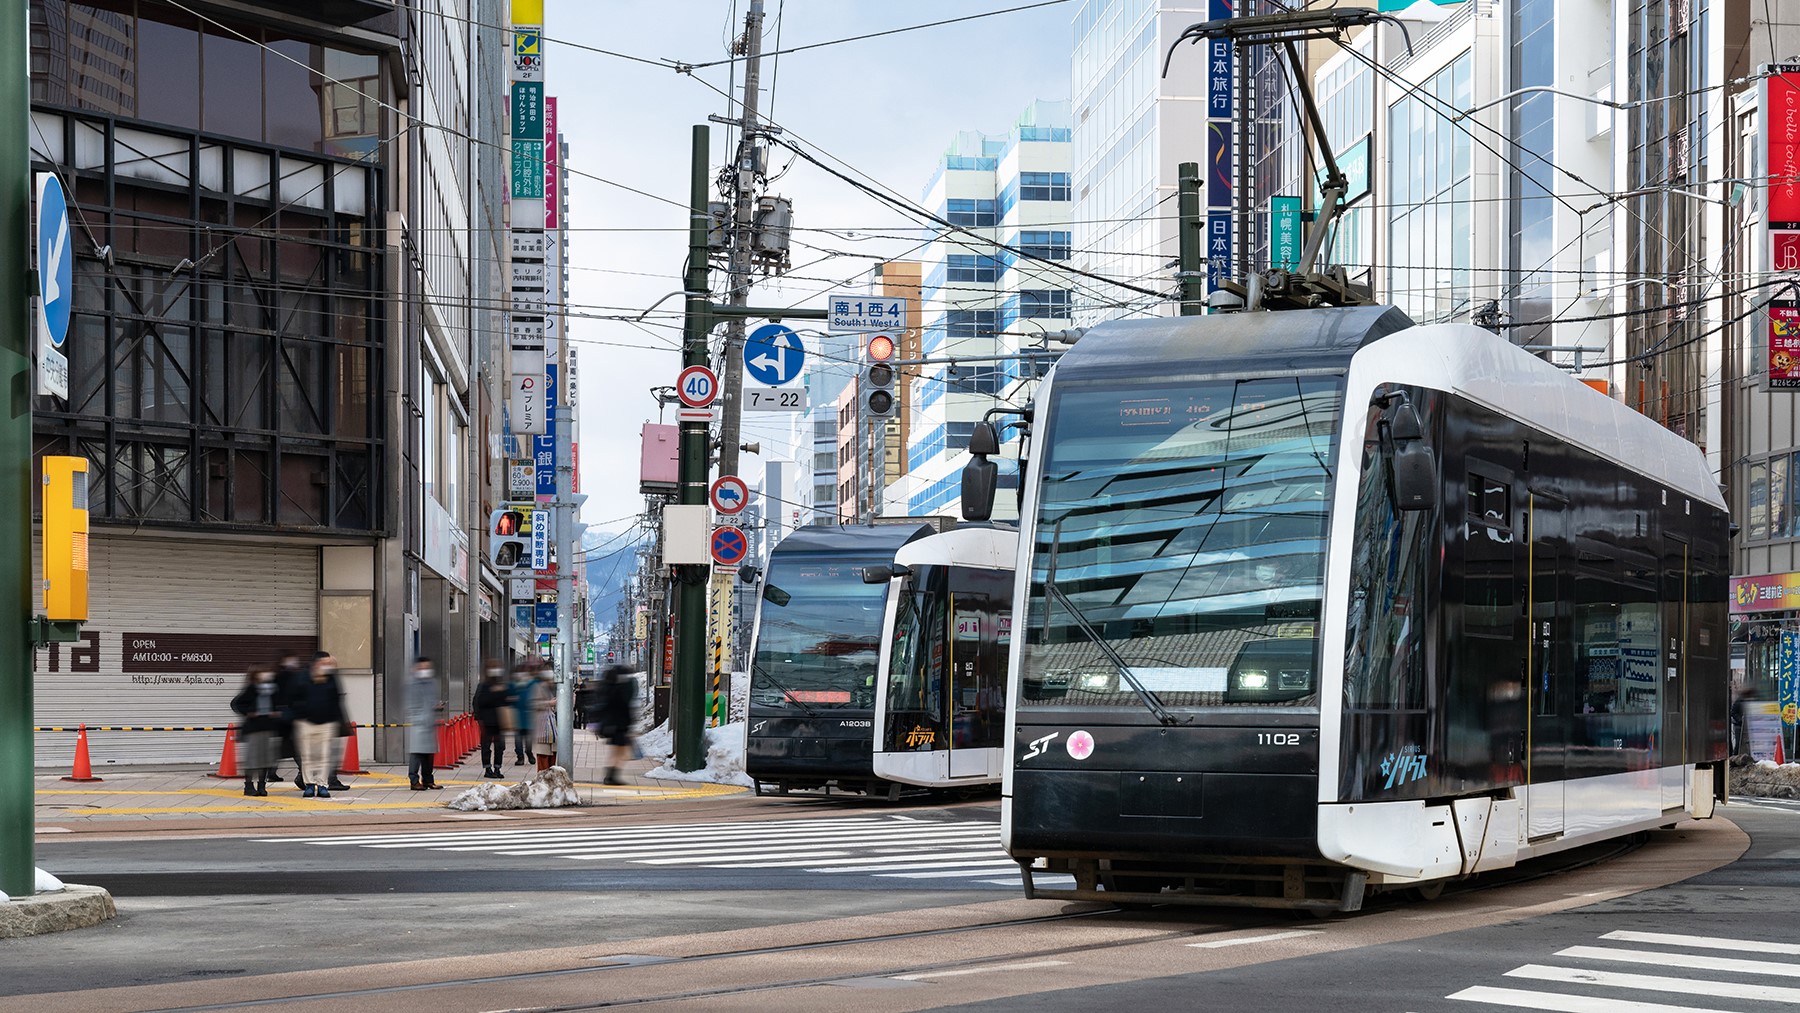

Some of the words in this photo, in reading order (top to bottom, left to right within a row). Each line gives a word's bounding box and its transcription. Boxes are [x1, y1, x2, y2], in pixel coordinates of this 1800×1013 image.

[514, 56, 540, 66] JOG
[1212, 42, 1228, 109] 日本旅行
[529, 87, 537, 122] 明治安田の
[1785, 90, 1797, 107] Le
[1785, 109, 1797, 143] belle
[523, 142, 532, 196] 歯科口腔外科
[834, 301, 900, 318] 南1西4
[1773, 318, 1800, 337] ビッ
[686, 377, 710, 396] 40
[525, 395, 533, 430] プレミア
[535, 513, 545, 567] 斜め横断専用
[1737, 580, 1760, 607] ビッグ
[132, 640, 156, 649] OPEN
[132, 652, 172, 662] AM10:00
[181, 653, 213, 662] PM8:00
[1782, 635, 1793, 701] キャンペーン
[132, 674, 225, 685] http://www.4pla.co.jp
[751, 719, 767, 734] ST
[905, 725, 936, 747] ポラリス
[1022, 731, 1059, 761] ST
[1257, 733, 1300, 746] 1102
